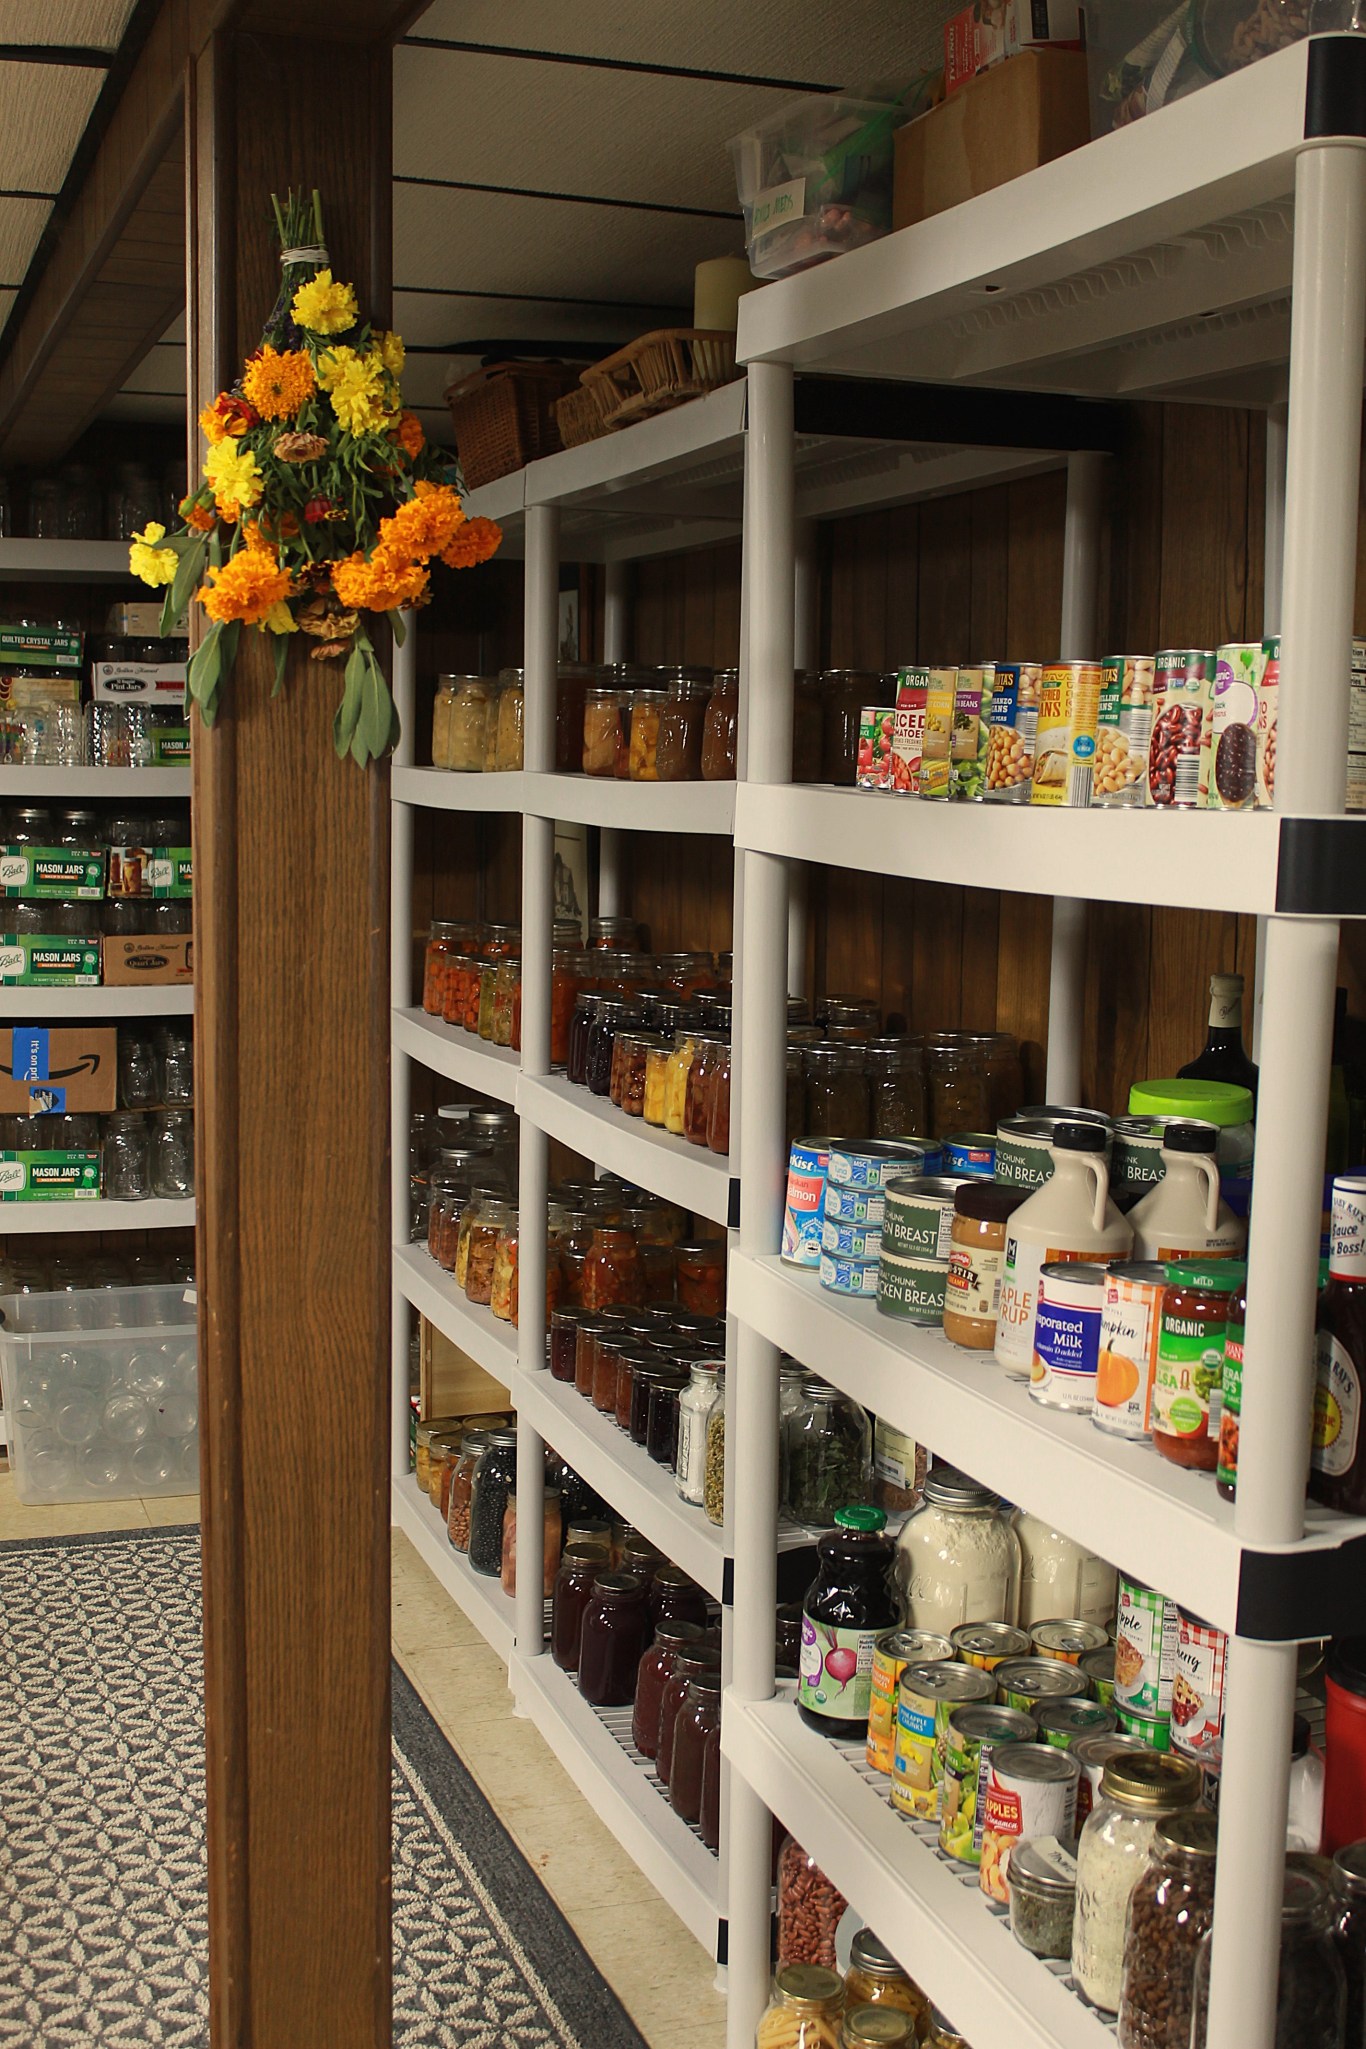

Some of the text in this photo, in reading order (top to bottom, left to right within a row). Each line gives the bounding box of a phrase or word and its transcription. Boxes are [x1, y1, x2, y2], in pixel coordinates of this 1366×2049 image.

[1, 634, 24, 644] QUILTED
[26, 636, 51, 645] CRYSTAL
[53, 638, 68, 647] JARS
[1157, 657, 1185, 668] ORGANIC
[960, 700, 978, 708] BEANS
[161, 741, 184, 749] MASON
[2, 864, 25, 878] Ball
[36, 863, 84, 874] MASON JARS
[150, 866, 169, 880] Ball
[32, 952, 81, 962] MASON JARS
[31, 1040, 39, 1053] It's
[31, 1054, 37, 1066] on
[853, 1160, 867, 1169] MSC
[1002, 1152, 1025, 1165] CHUNK
[32, 1167, 80, 1176] MASON JARS
[842, 1193, 854, 1201] MSC
[839, 1228, 852, 1237] MSC
[894, 1225, 937, 1245] BREAST
[1336, 1238, 1365, 1254] Boss!
[837, 1263, 850, 1272] MSC
[890, 1274, 917, 1288] CHUNK
[1192, 1276, 1213, 1287] MILD
[1165, 1316, 1205, 1337] ORGANIC
[1053, 1332, 1082, 1349] Milk
[1060, 1347, 1083, 1358] added
[900, 1708, 928, 1727] PINEAPPLE
[901, 1716, 924, 1732] CHUNKS
[986, 1799, 1018, 1820] APPLES
[986, 1815, 1018, 1830] Cinnamon
